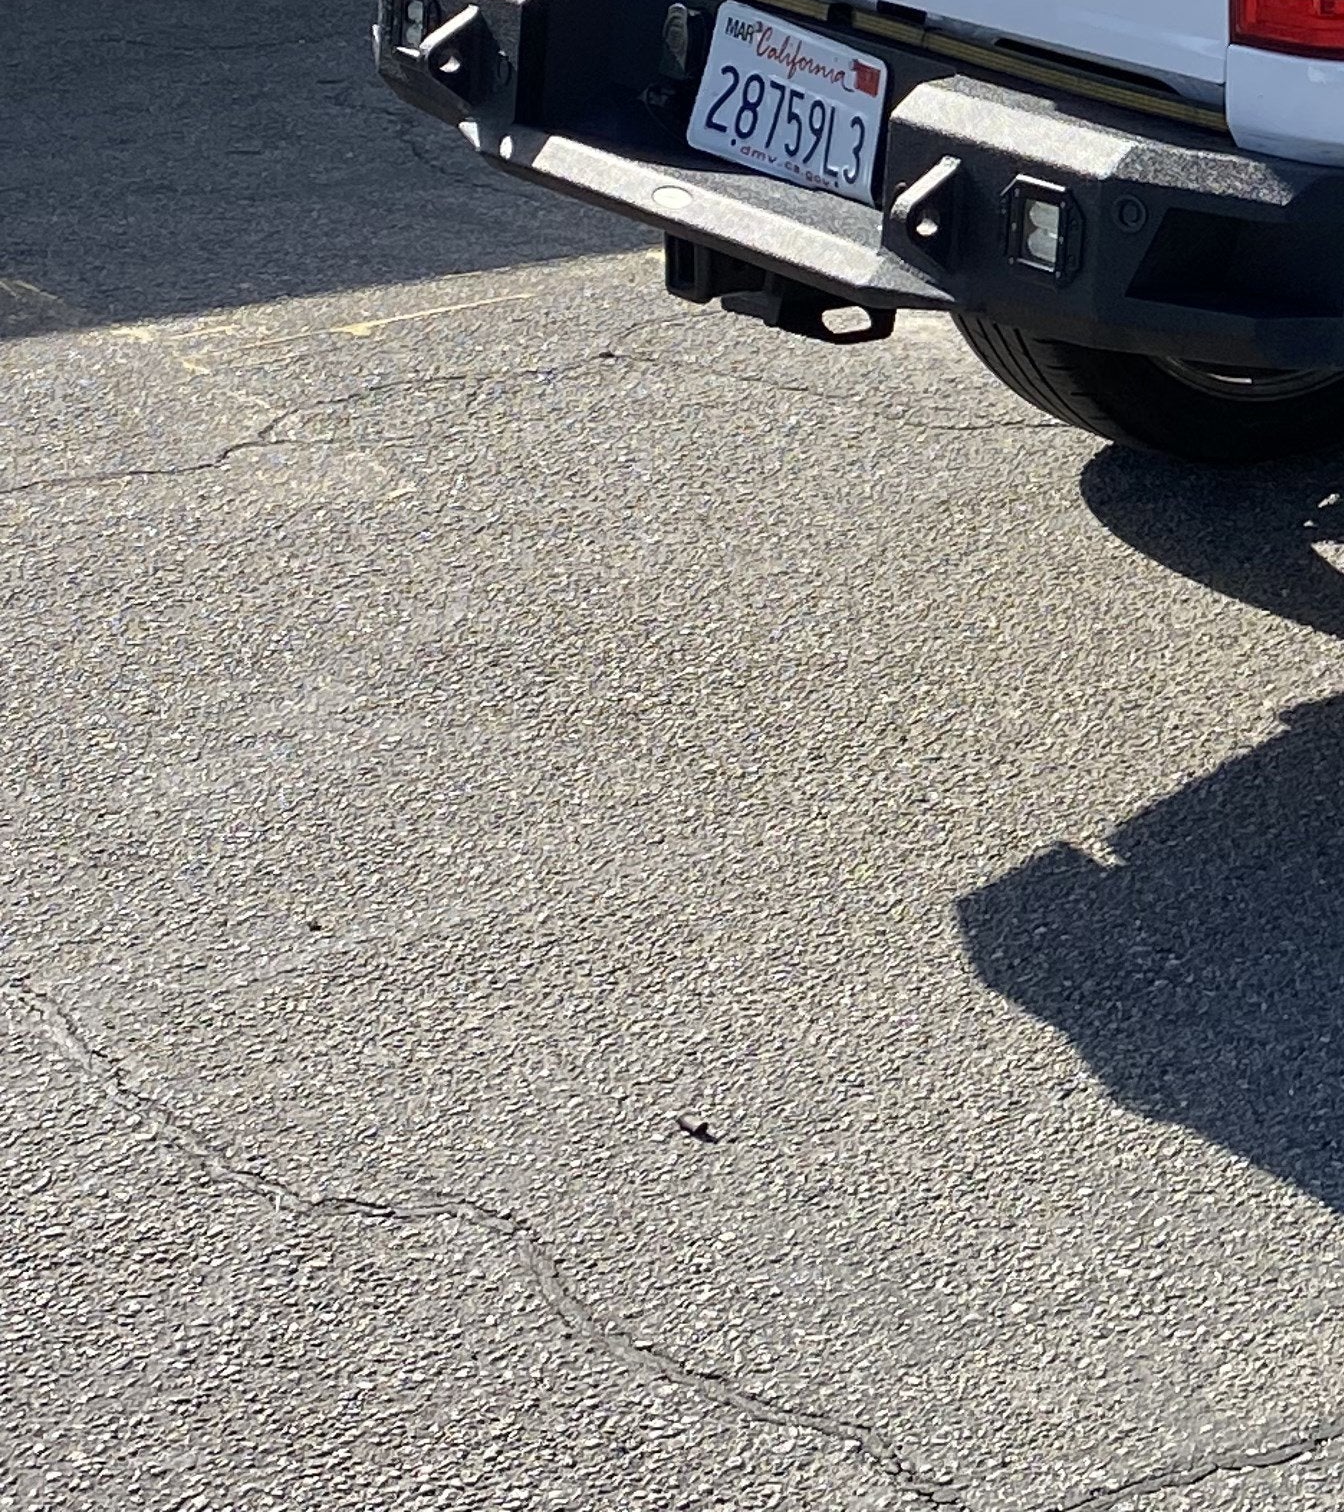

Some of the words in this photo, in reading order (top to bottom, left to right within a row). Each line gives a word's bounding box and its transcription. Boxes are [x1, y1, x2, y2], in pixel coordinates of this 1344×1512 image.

[725, 16, 754, 44] MAR
[756, 26, 855, 93] California
[705, 65, 865, 184] 28759L3
